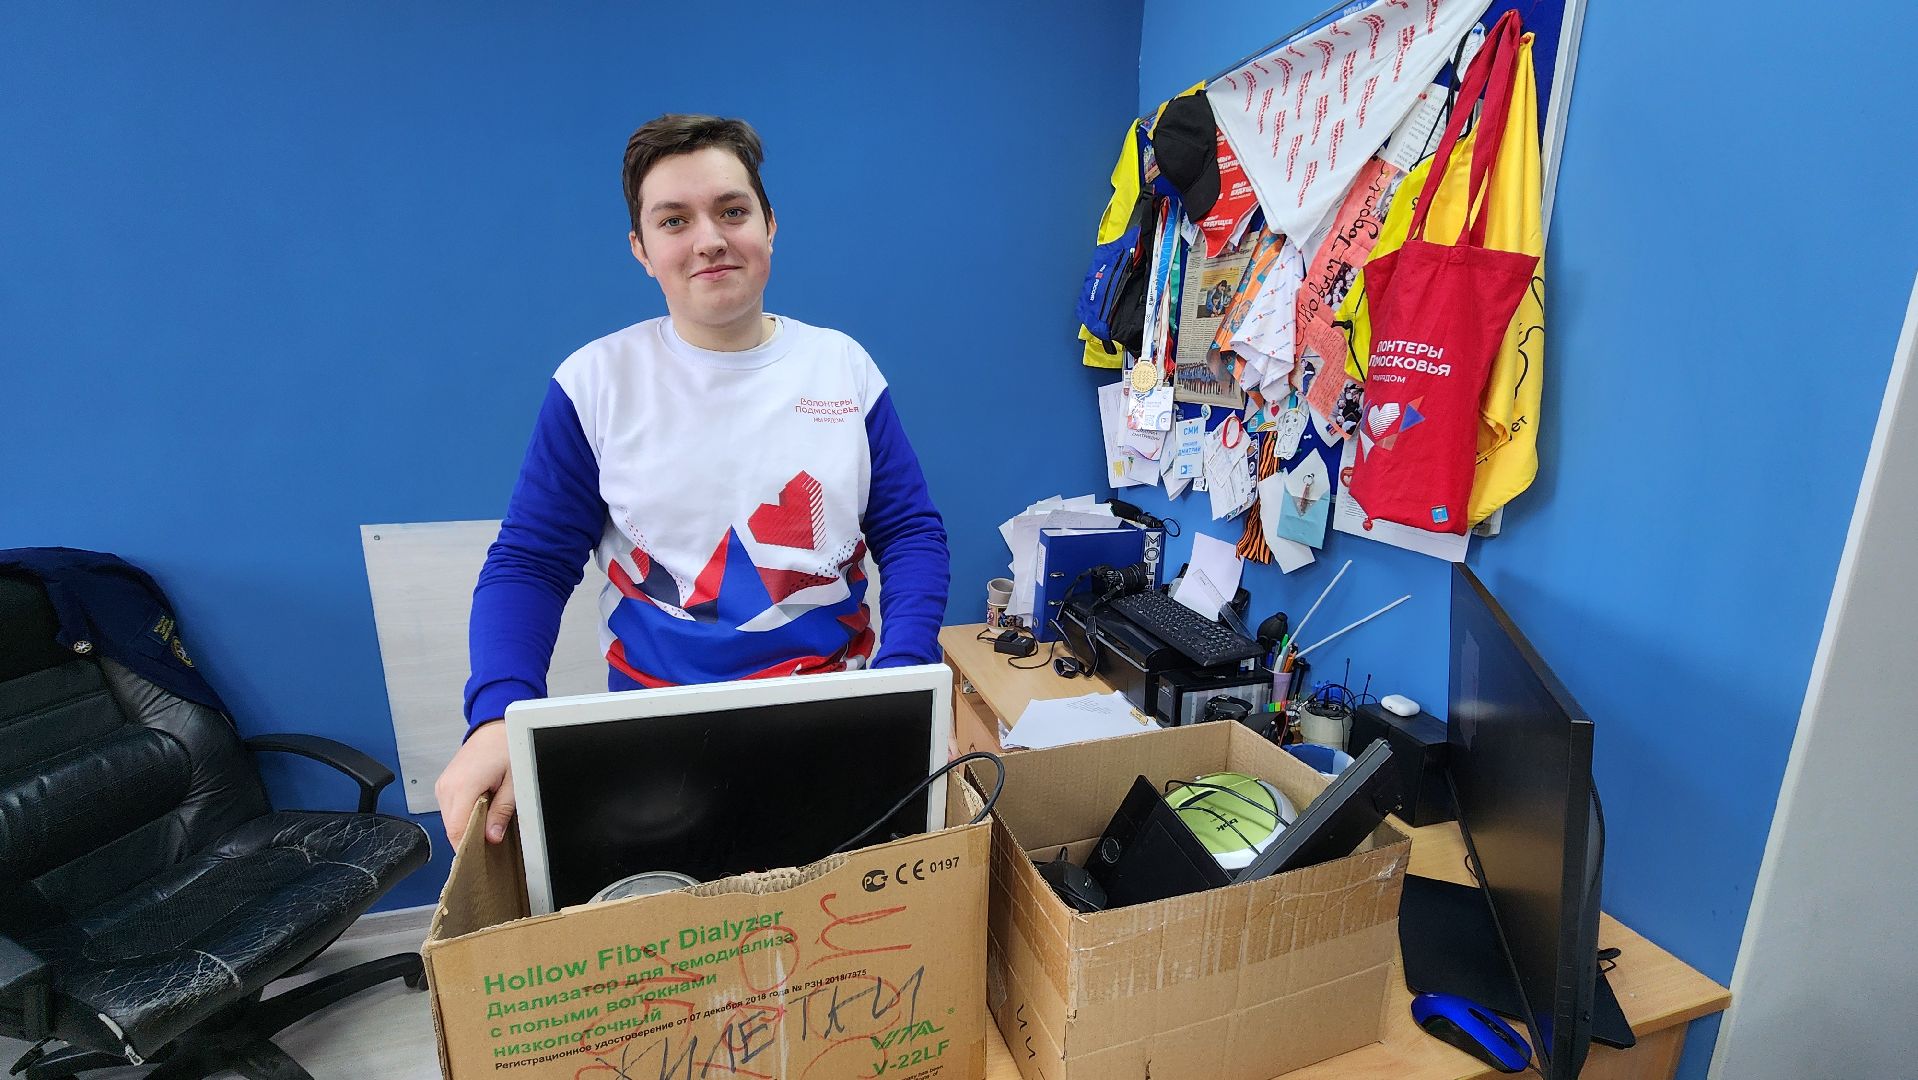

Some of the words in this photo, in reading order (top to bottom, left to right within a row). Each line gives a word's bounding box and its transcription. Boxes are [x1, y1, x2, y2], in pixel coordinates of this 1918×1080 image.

[1183, 425, 1199, 436] СМИ
[929, 856, 960, 874] 0197
[483, 960, 588, 996] Hollow
[597, 937, 671, 971] Fiber
[678, 911, 784, 950] Dialyzer
[487, 978, 620, 1021] Диализатор
[624, 967, 664, 989] для
[670, 933, 795, 974] гемодиализа
[490, 1027, 502, 1038] с
[509, 1007, 599, 1036] полыми
[606, 973, 717, 1013] волокнами
[495, 1044, 592, 1071] Регистрационное
[594, 1022, 675, 1051] удостоверение
[676, 1016, 688, 1026] от
[689, 1011, 701, 1022] 07
[703, 1001, 743, 1018] декабря
[745, 993, 767, 1006] 2018
[769, 987, 790, 1000] года
[493, 1009, 663, 1058] низкопоточный
[870, 1019, 945, 1050] VITAL
[872, 1039, 950, 1076] V-22LF
